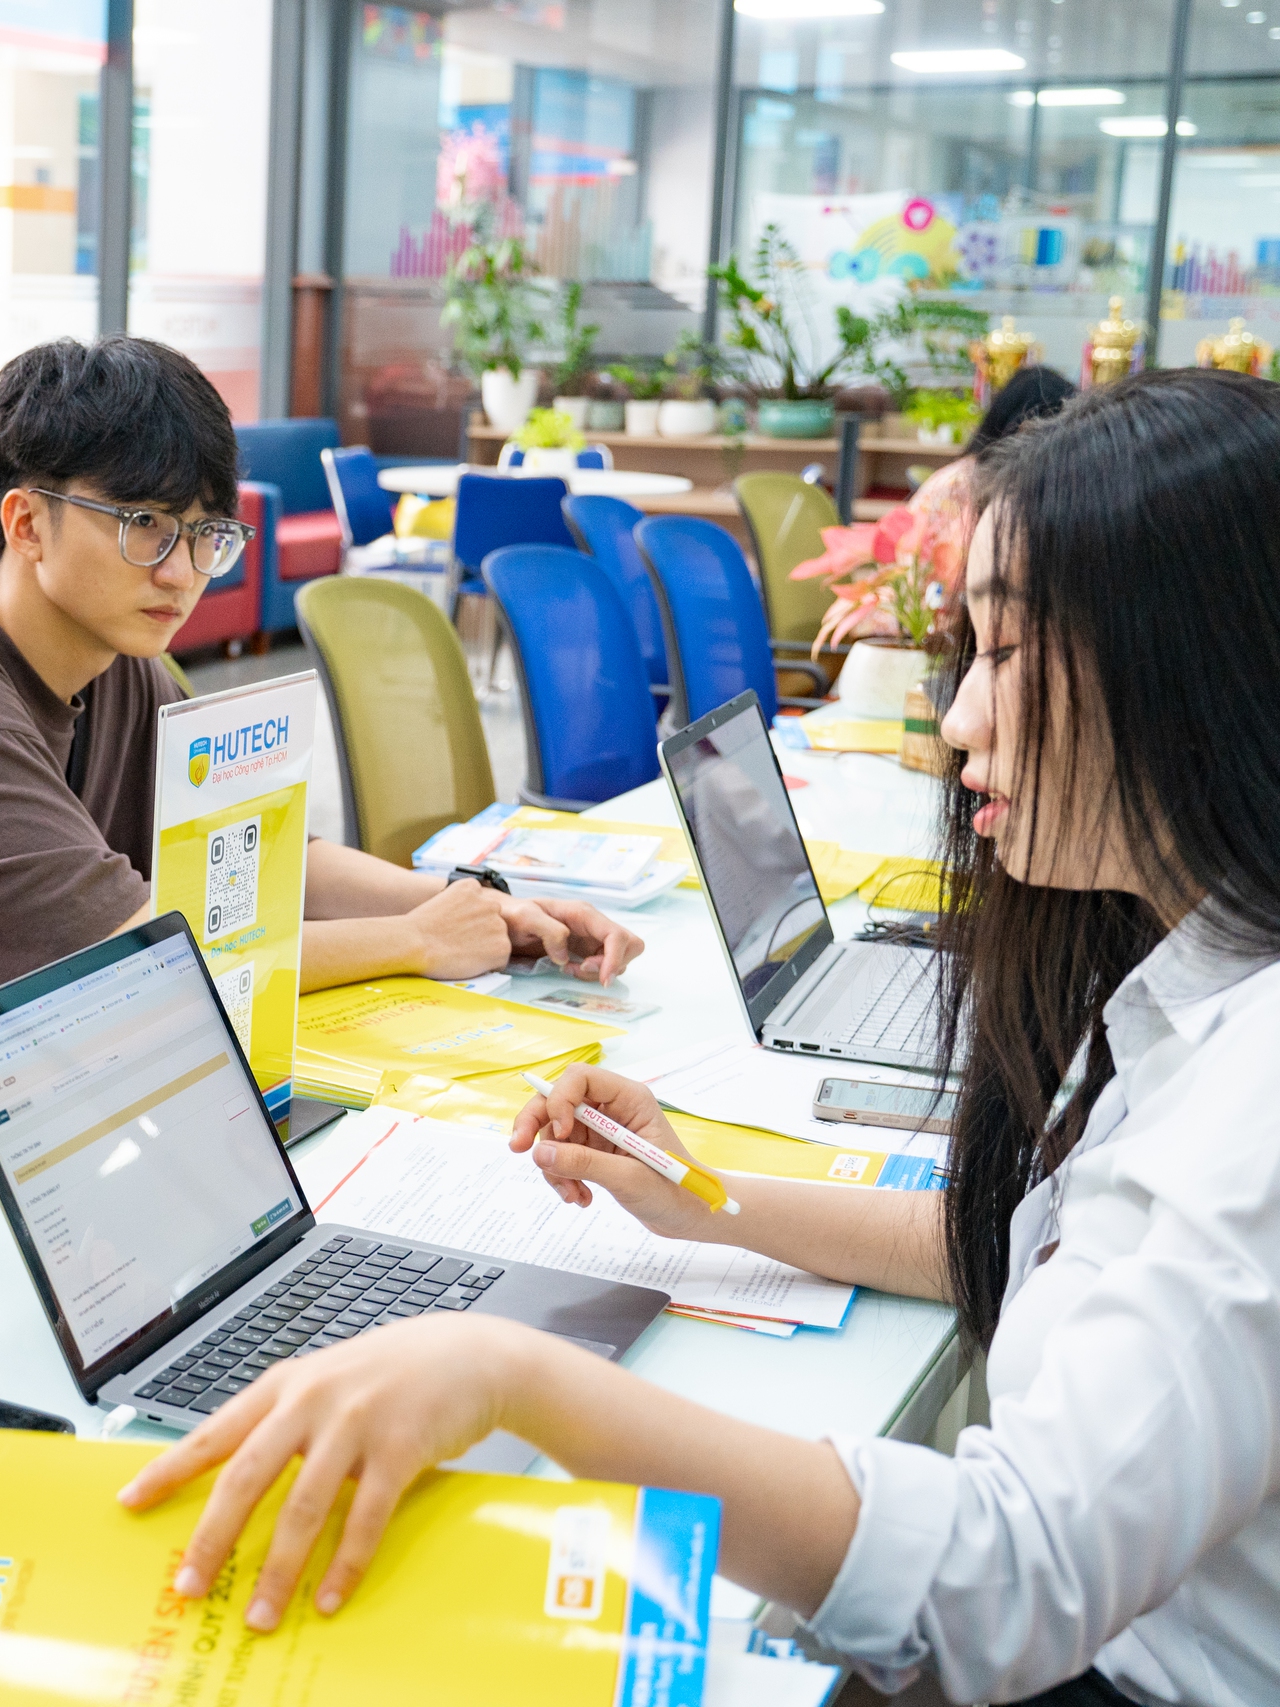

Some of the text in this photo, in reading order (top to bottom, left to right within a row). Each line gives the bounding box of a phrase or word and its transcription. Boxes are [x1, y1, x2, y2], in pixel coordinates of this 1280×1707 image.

[213, 715, 289, 765] HUTECH
[239, 926, 266, 946] HUTECH
[583, 1107, 619, 1134] HUTECH
